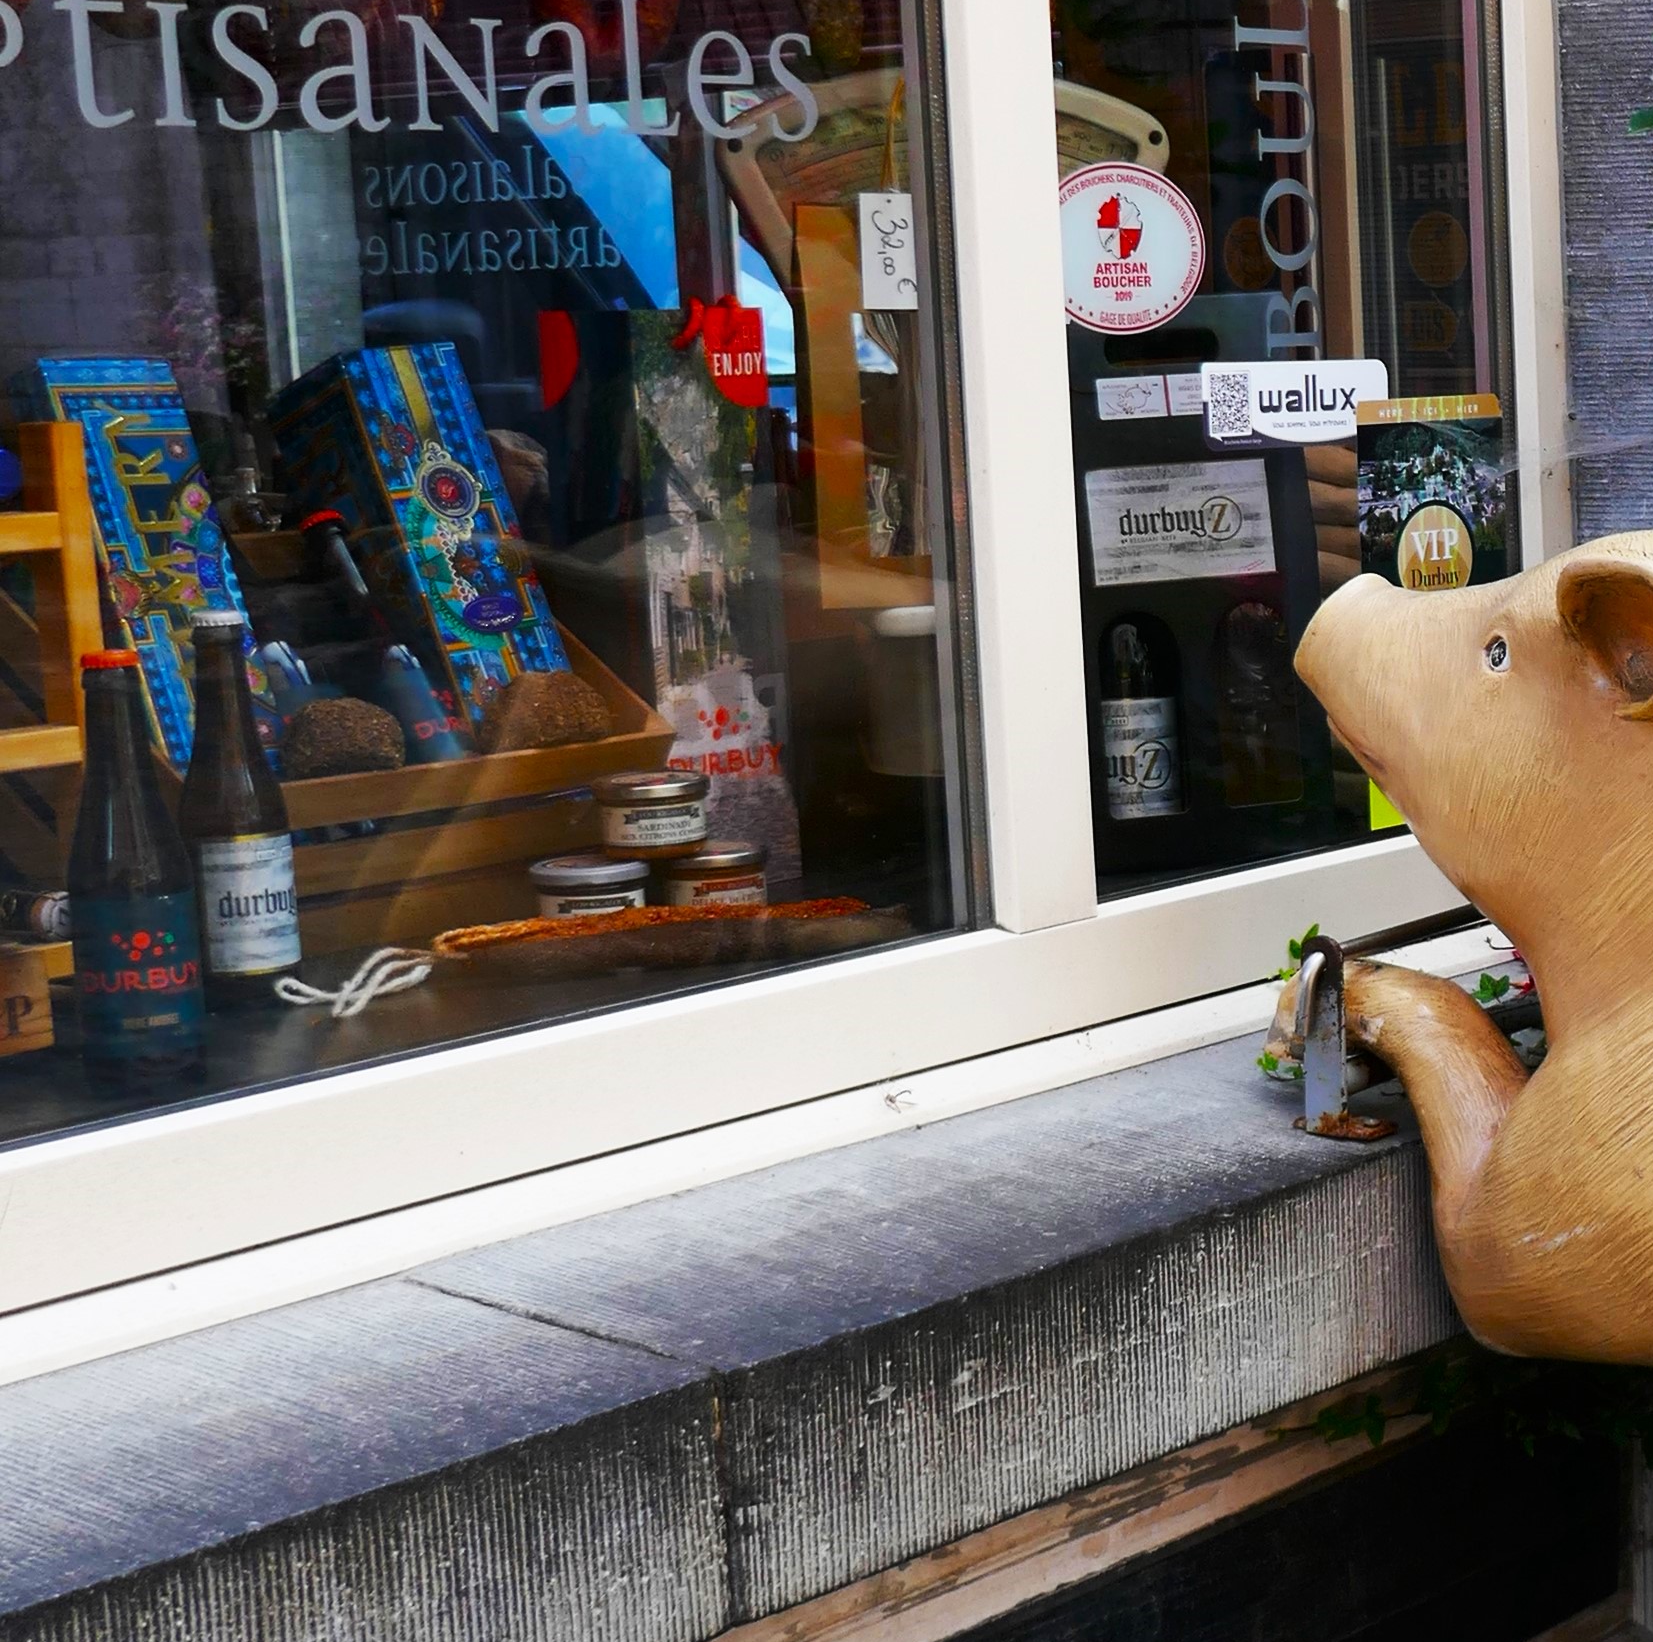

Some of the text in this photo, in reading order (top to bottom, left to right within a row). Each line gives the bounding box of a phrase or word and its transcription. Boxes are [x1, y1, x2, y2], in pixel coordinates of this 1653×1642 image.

[1095, 262, 1148, 275] ARTISAN
[1093, 276, 1152, 289] BOUCHER
[713, 351, 762, 376] ENJOY
[1258, 374, 1357, 413] wallux
[1410, 527, 1460, 564] VIP
[1411, 566, 1461, 589] Durbuy
